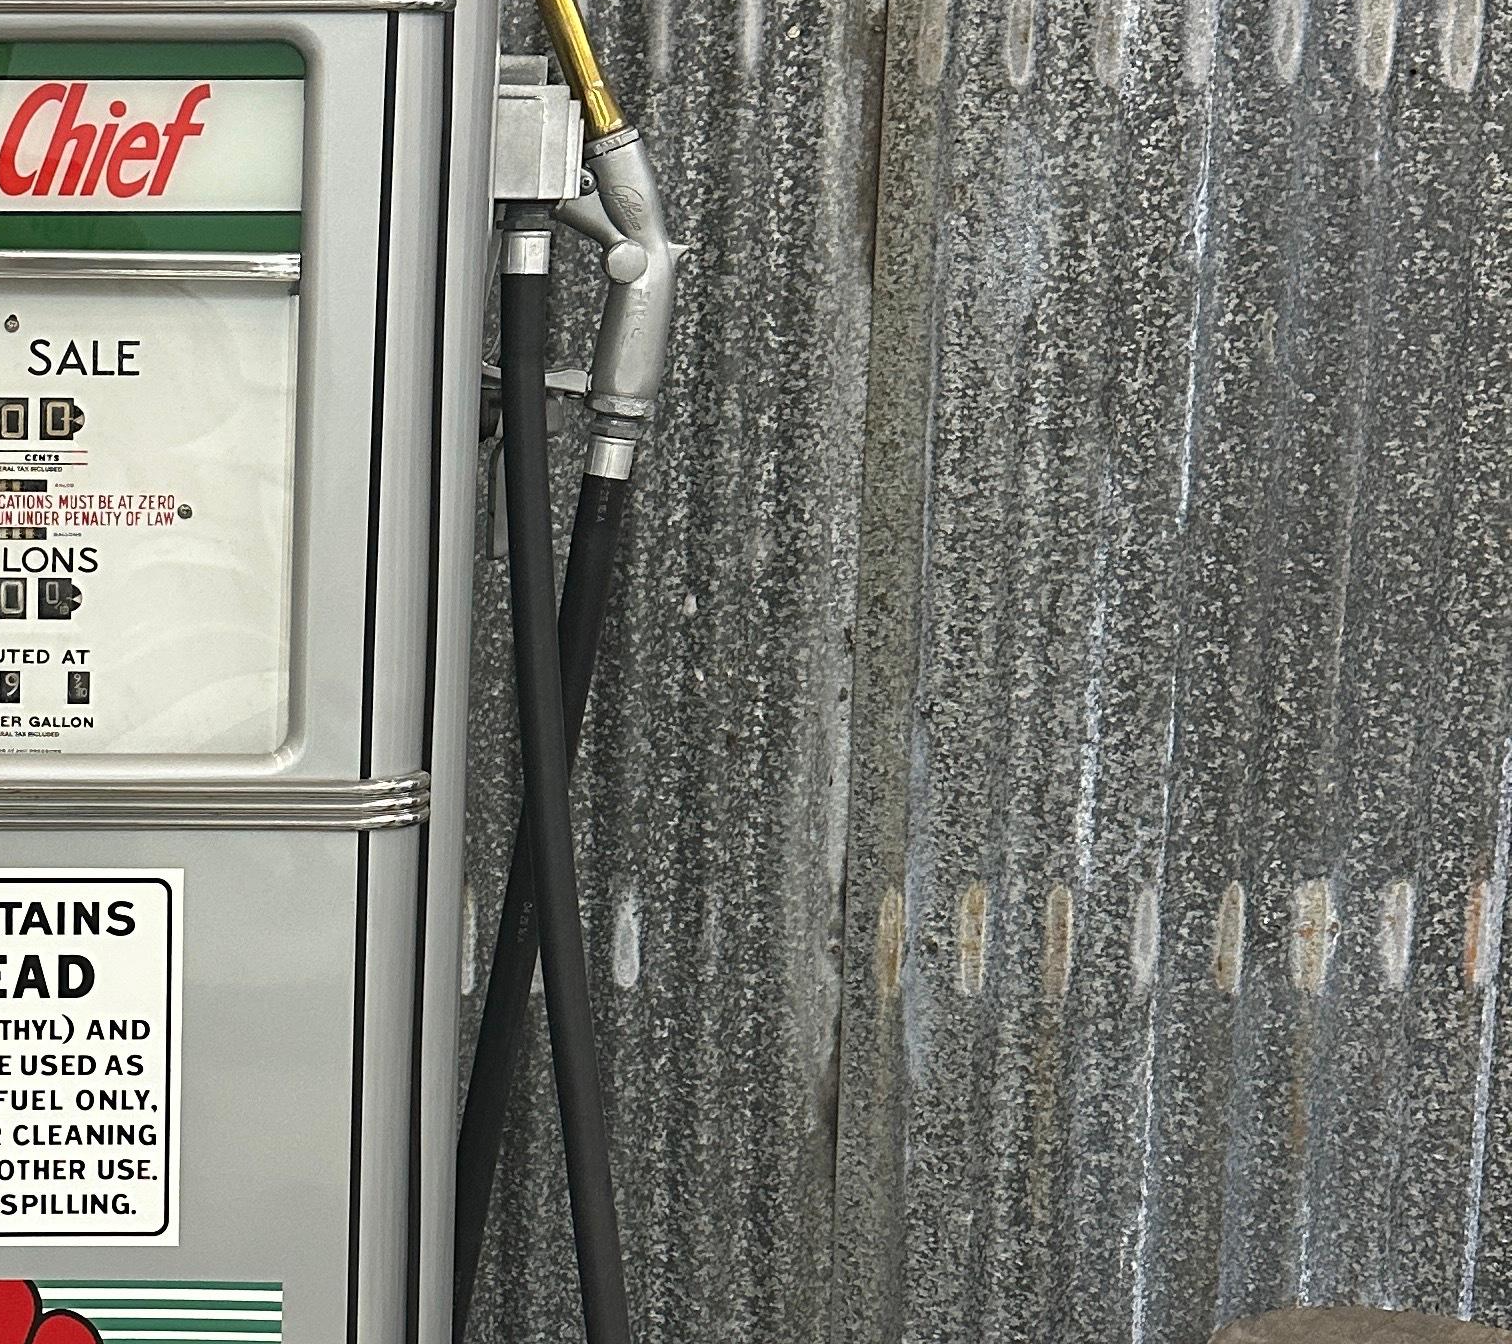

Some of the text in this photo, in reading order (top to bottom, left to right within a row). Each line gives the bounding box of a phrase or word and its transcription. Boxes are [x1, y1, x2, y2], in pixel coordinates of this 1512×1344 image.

[28, 339, 140, 376] SALE
[59, 495, 95, 509] MUST
[98, 495, 116, 509] BE
[118, 495, 133, 509] AT
[138, 495, 175, 510] ZERO
[17, 511, 59, 526] UNDER
[65, 511, 120, 526] PENALTY
[125, 511, 141, 526] OF
[147, 511, 174, 526] LAW
[61, 650, 90, 664] AT
[5, 673, 19, 696] 9
[29, 716, 94, 728] GALLON
[87, 1020, 150, 1040] AND
[21, 1055, 96, 1076] USED
[105, 1055, 143, 1076] AS
[76, 1090, 157, 1112] ONLY,
[13, 1125, 156, 1146] CLEANING
[98, 1159, 157, 1180] USE.
[1, 1194, 136, 1215] SPILLING.
